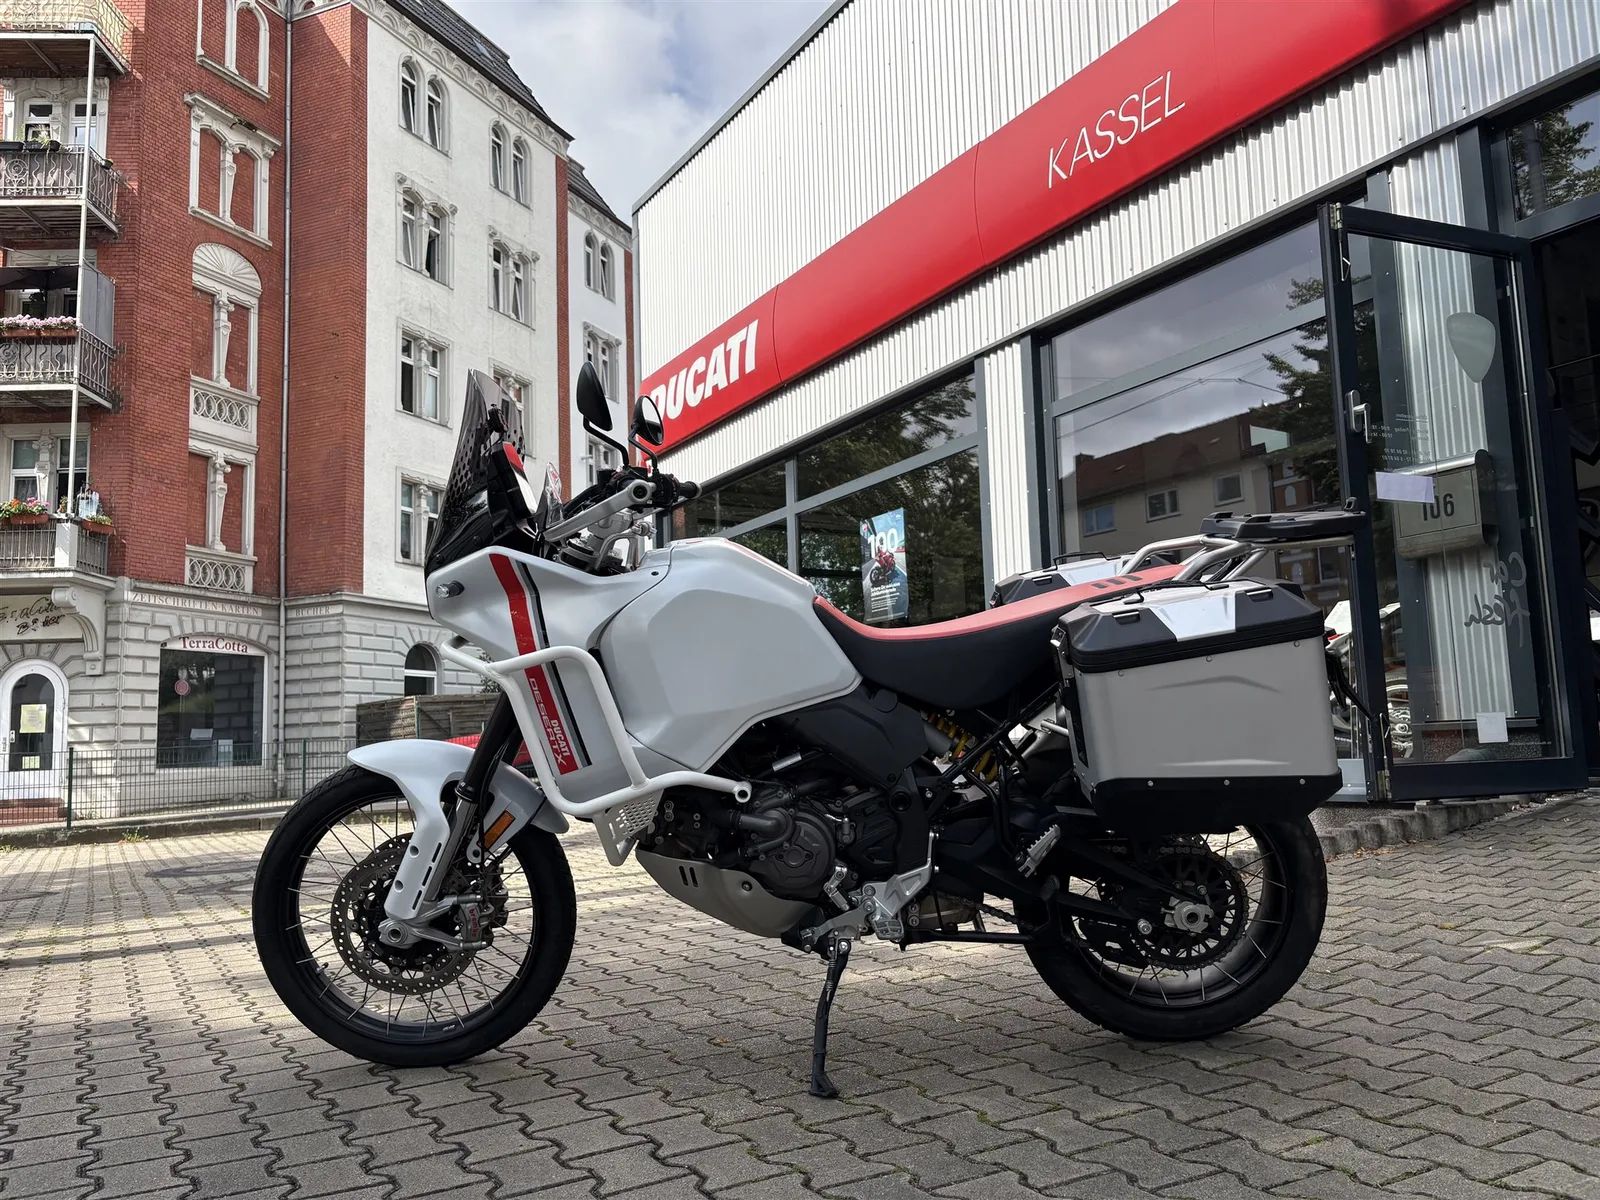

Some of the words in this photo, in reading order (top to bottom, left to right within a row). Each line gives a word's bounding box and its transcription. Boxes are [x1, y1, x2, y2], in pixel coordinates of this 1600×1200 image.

[1048, 70, 1186, 189] KASSEL
[179, 636, 248, 654] TerraCotta
[551, 719, 571, 756] DUCATI
